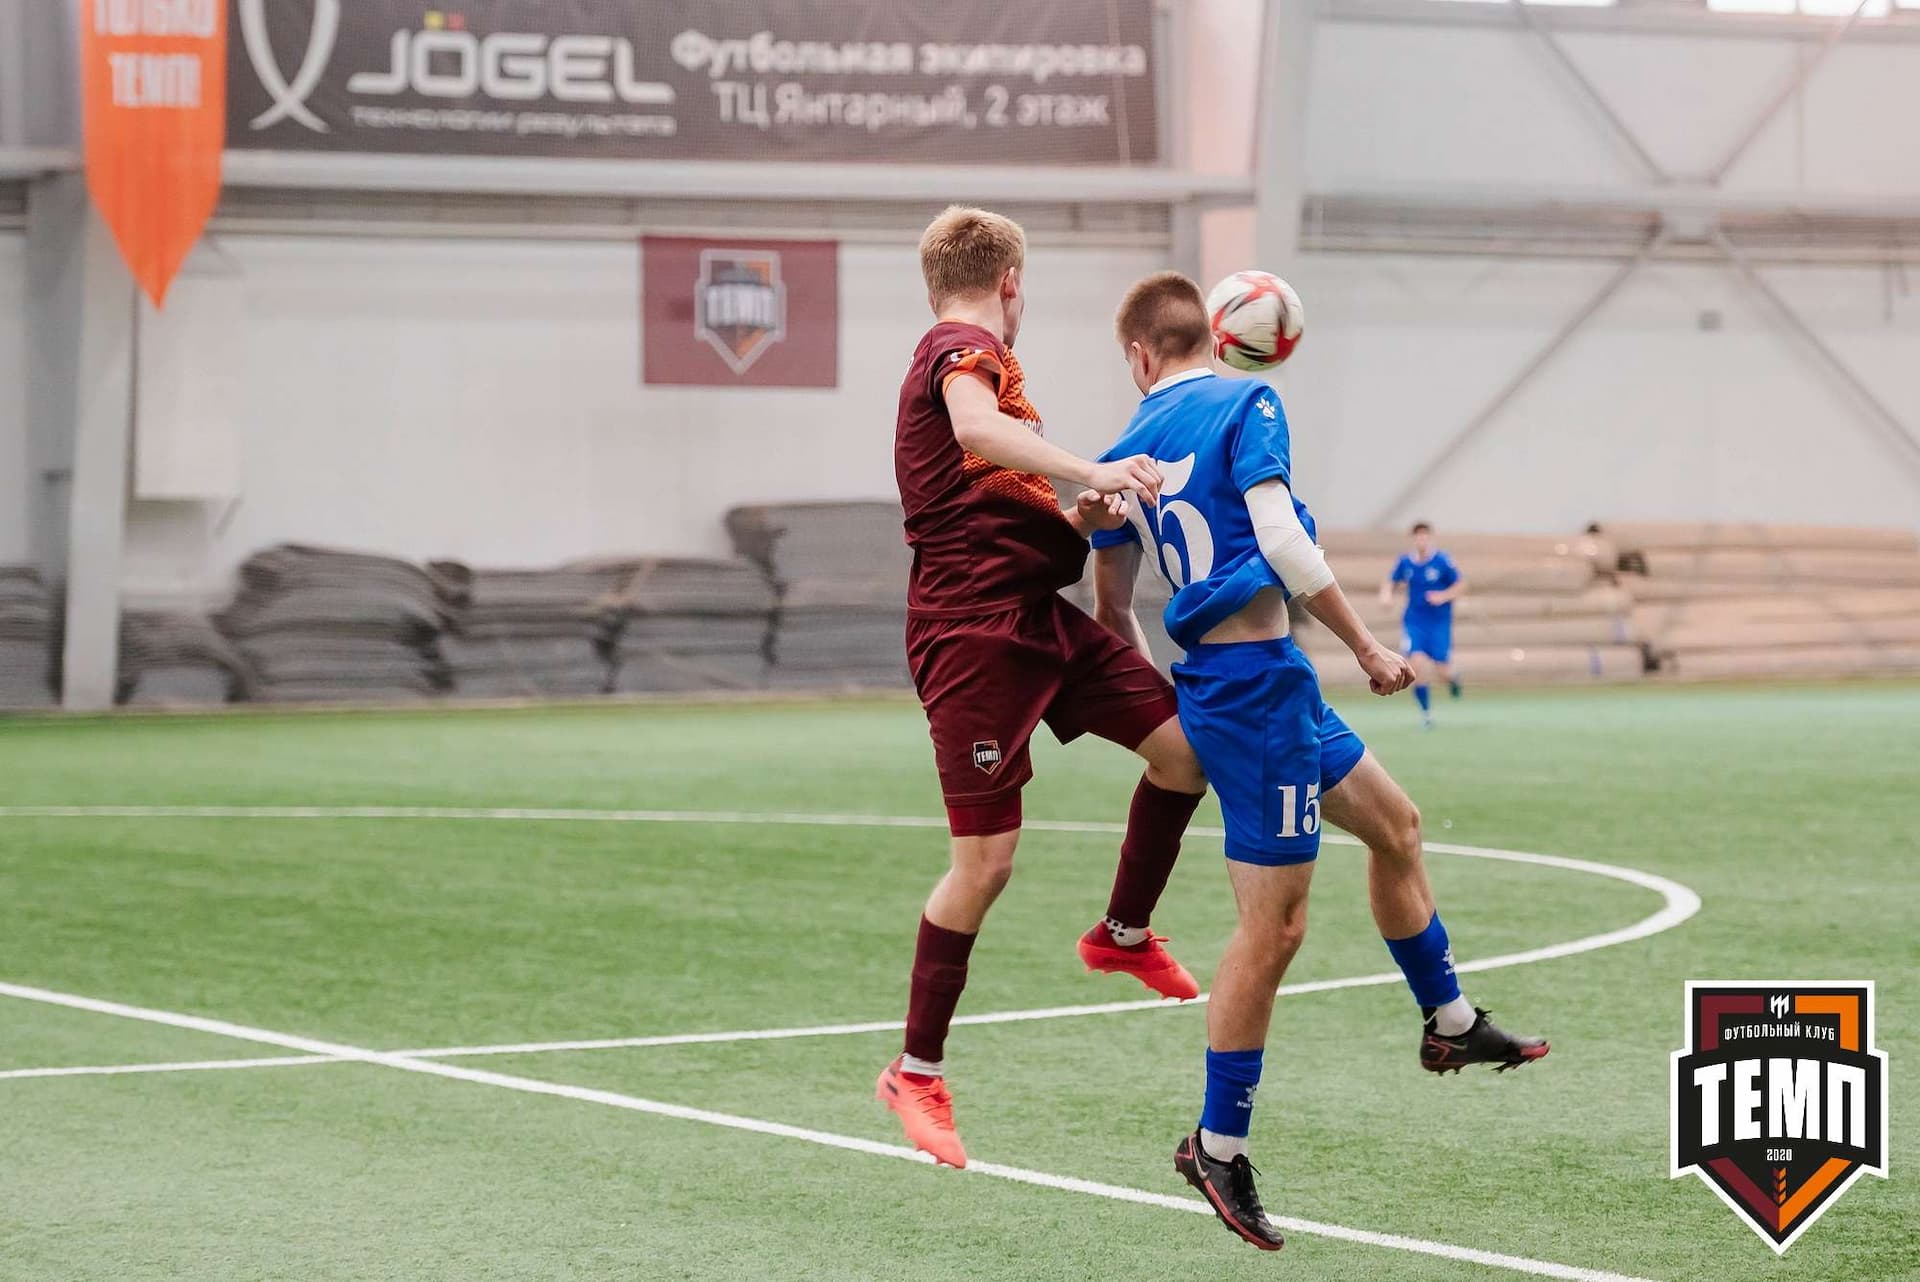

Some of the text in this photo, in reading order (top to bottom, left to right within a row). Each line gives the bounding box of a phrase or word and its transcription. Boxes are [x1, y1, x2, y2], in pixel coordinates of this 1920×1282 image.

[671, 30, 1147, 83] Футбольная экипировка
[711, 82, 769, 130] ТЦ
[984, 86, 1009, 125] 2
[1016, 95, 1110, 127] этаж
[976, 750, 999, 763] ТЕМП
[1276, 783, 1321, 838] 15
